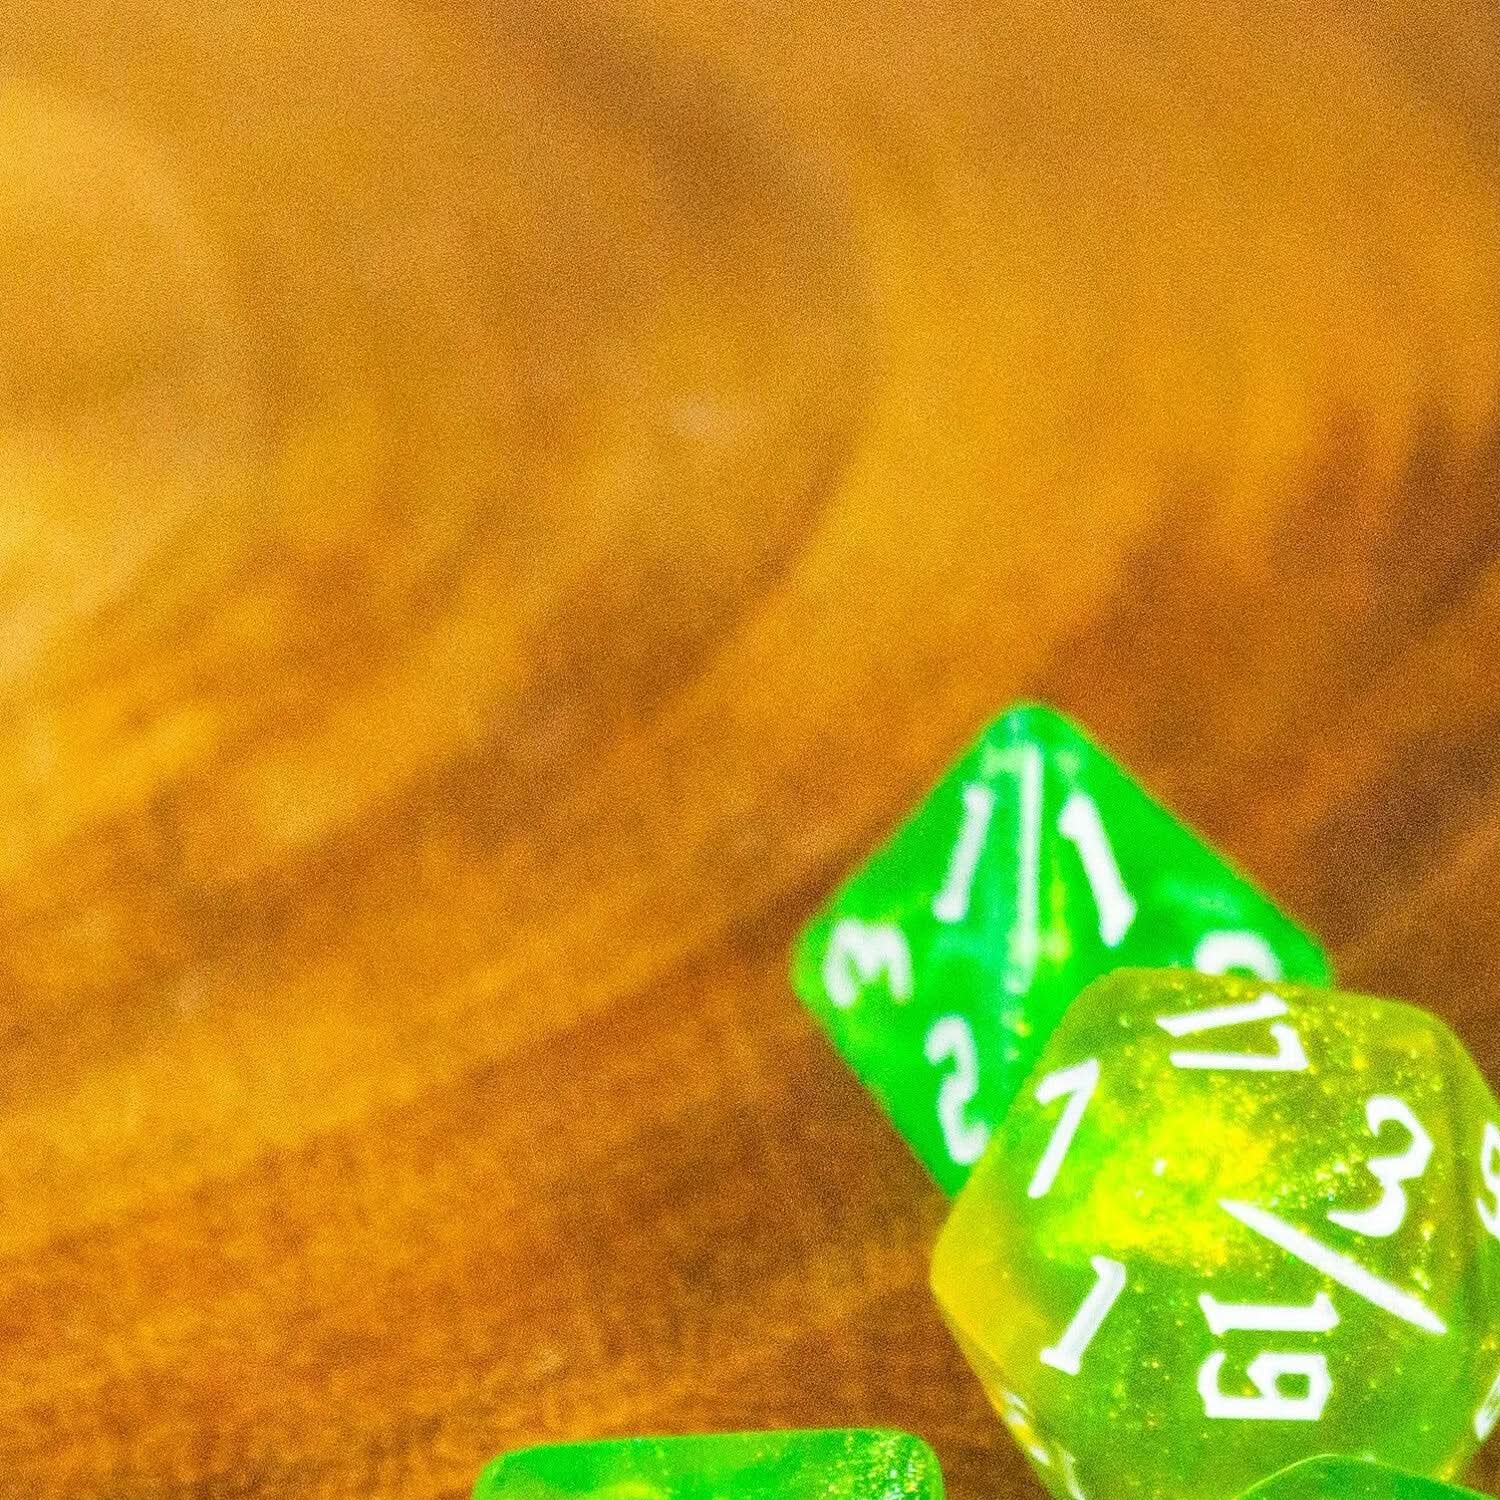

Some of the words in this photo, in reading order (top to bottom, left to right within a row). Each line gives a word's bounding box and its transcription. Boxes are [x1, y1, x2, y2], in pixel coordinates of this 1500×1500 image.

[933, 785, 993, 922] 1
[1058, 791, 1136, 947] 1
[822, 918, 912, 1009] 3
[925, 1016, 990, 1166] 2
[1326, 1094, 1434, 1238] 3
[1039, 1254, 1128, 1376] 1
[1196, 1290, 1341, 1422] 19
